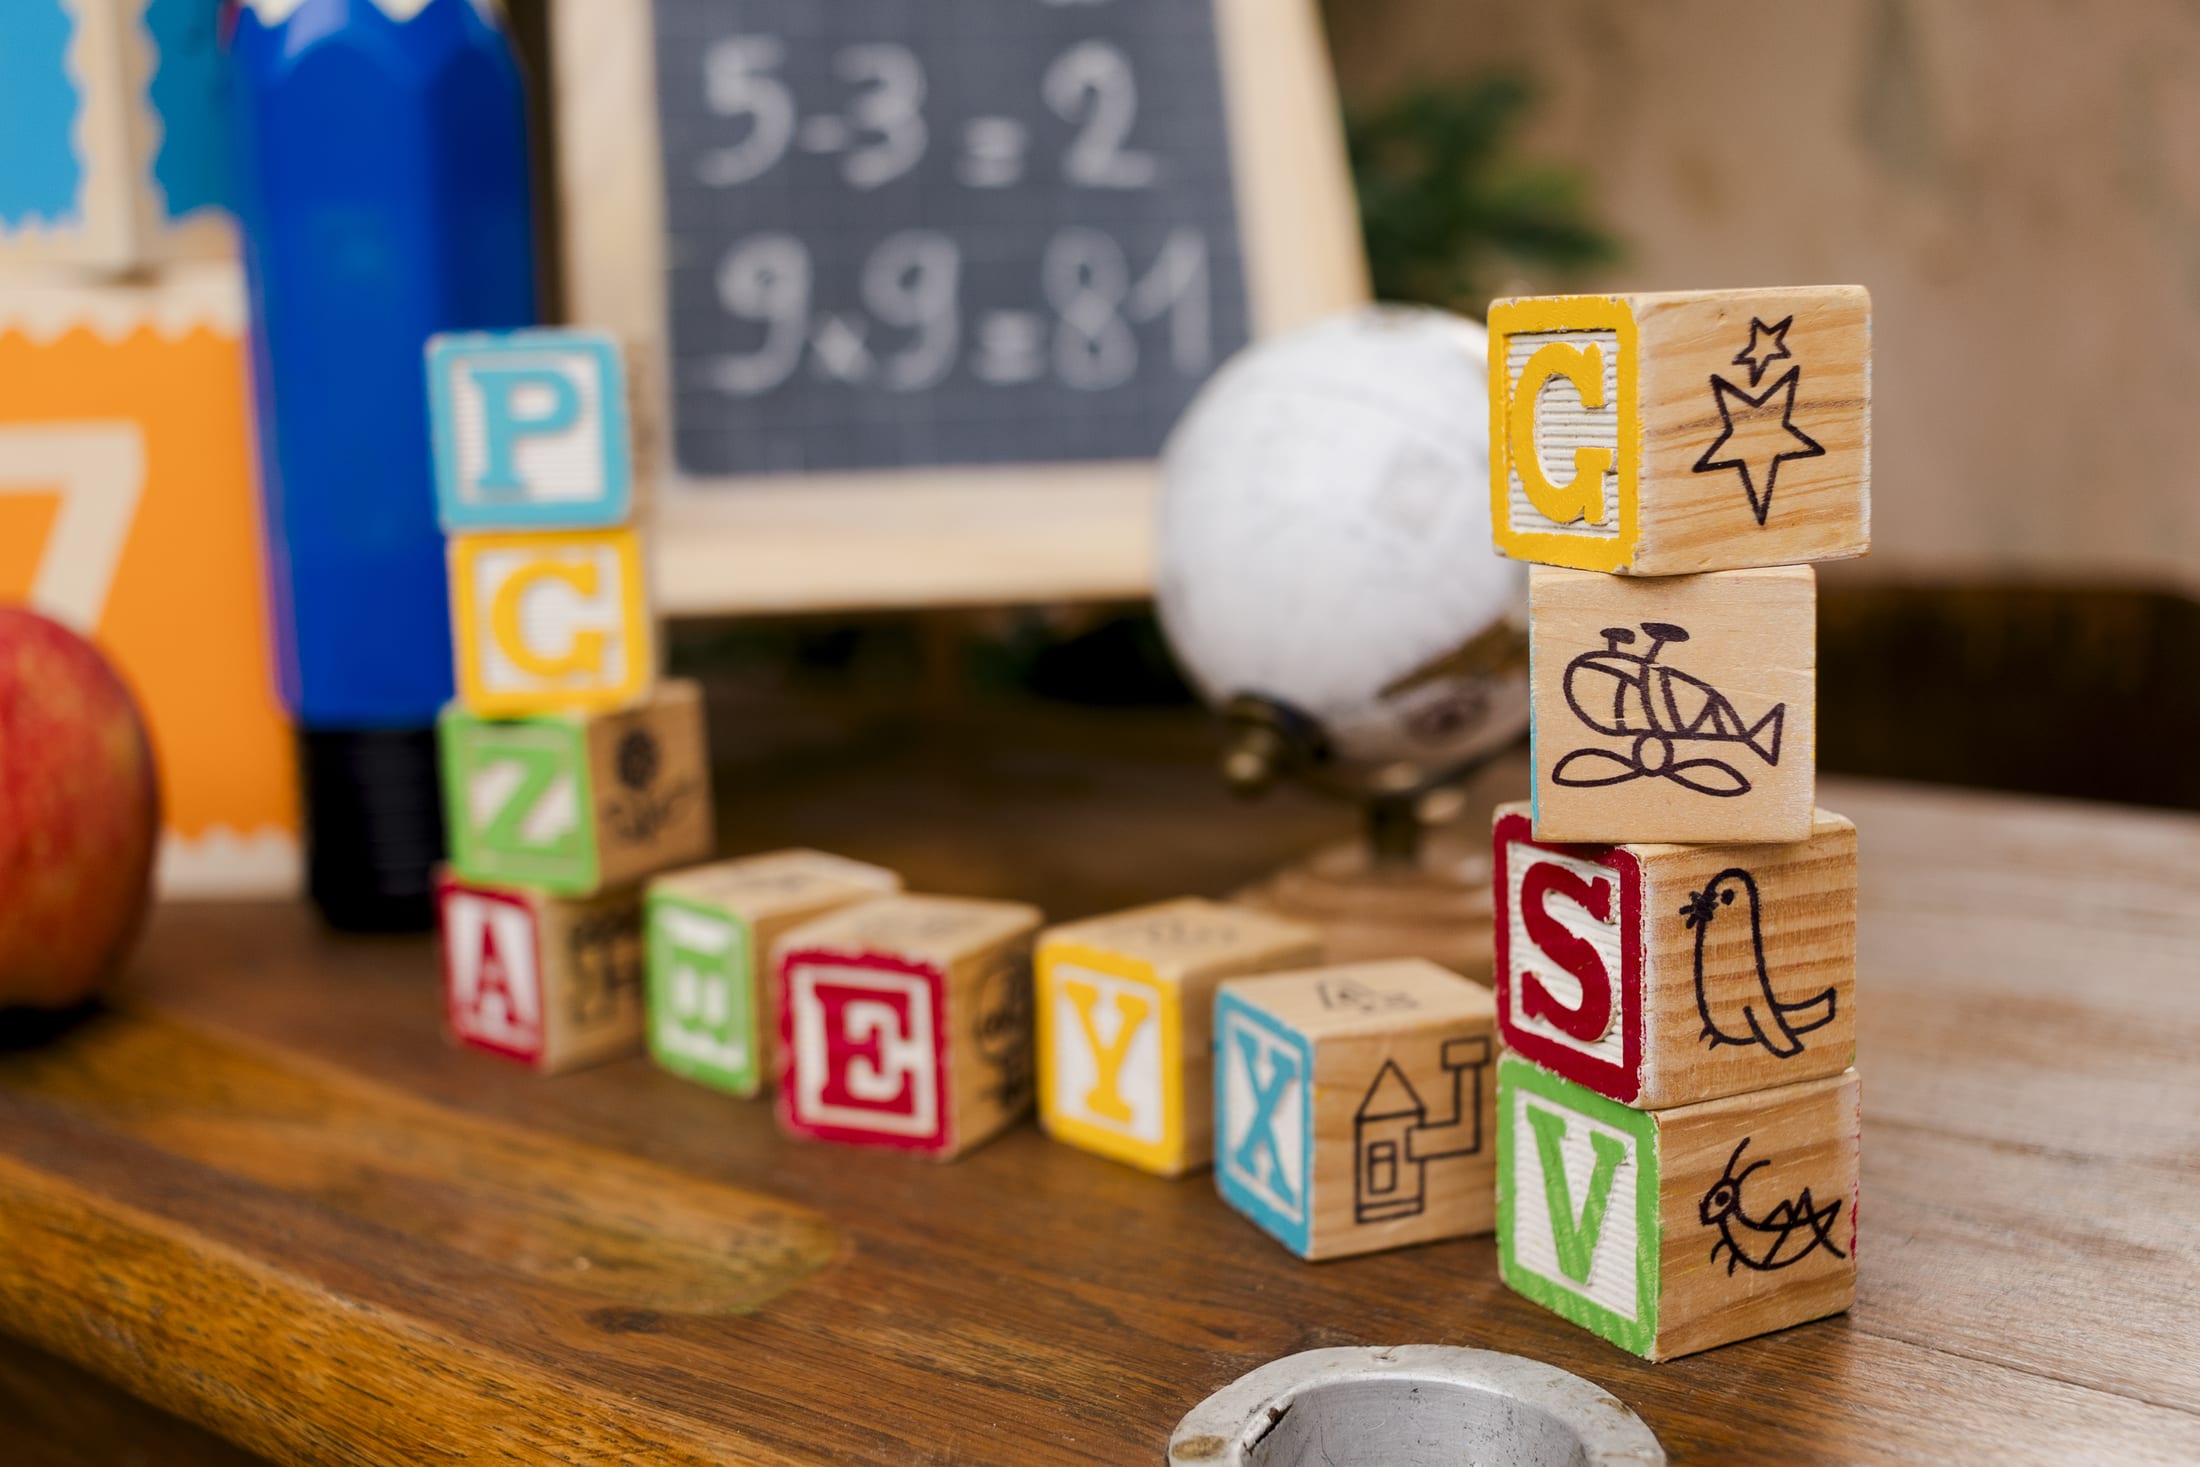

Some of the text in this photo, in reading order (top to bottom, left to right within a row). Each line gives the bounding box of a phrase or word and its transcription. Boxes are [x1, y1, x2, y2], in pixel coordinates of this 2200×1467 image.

[469, 368, 581, 488] P
[1511, 341, 1612, 525] G
[0, 421, 149, 636] 7
[474, 749, 577, 858] Z
[462, 908, 534, 1036] A
[1520, 860, 1612, 1043] S
[812, 980, 918, 1118] E
[1063, 979, 1150, 1125] Y
[1233, 1026, 1298, 1208] X
[1525, 1103, 1626, 1287] V
